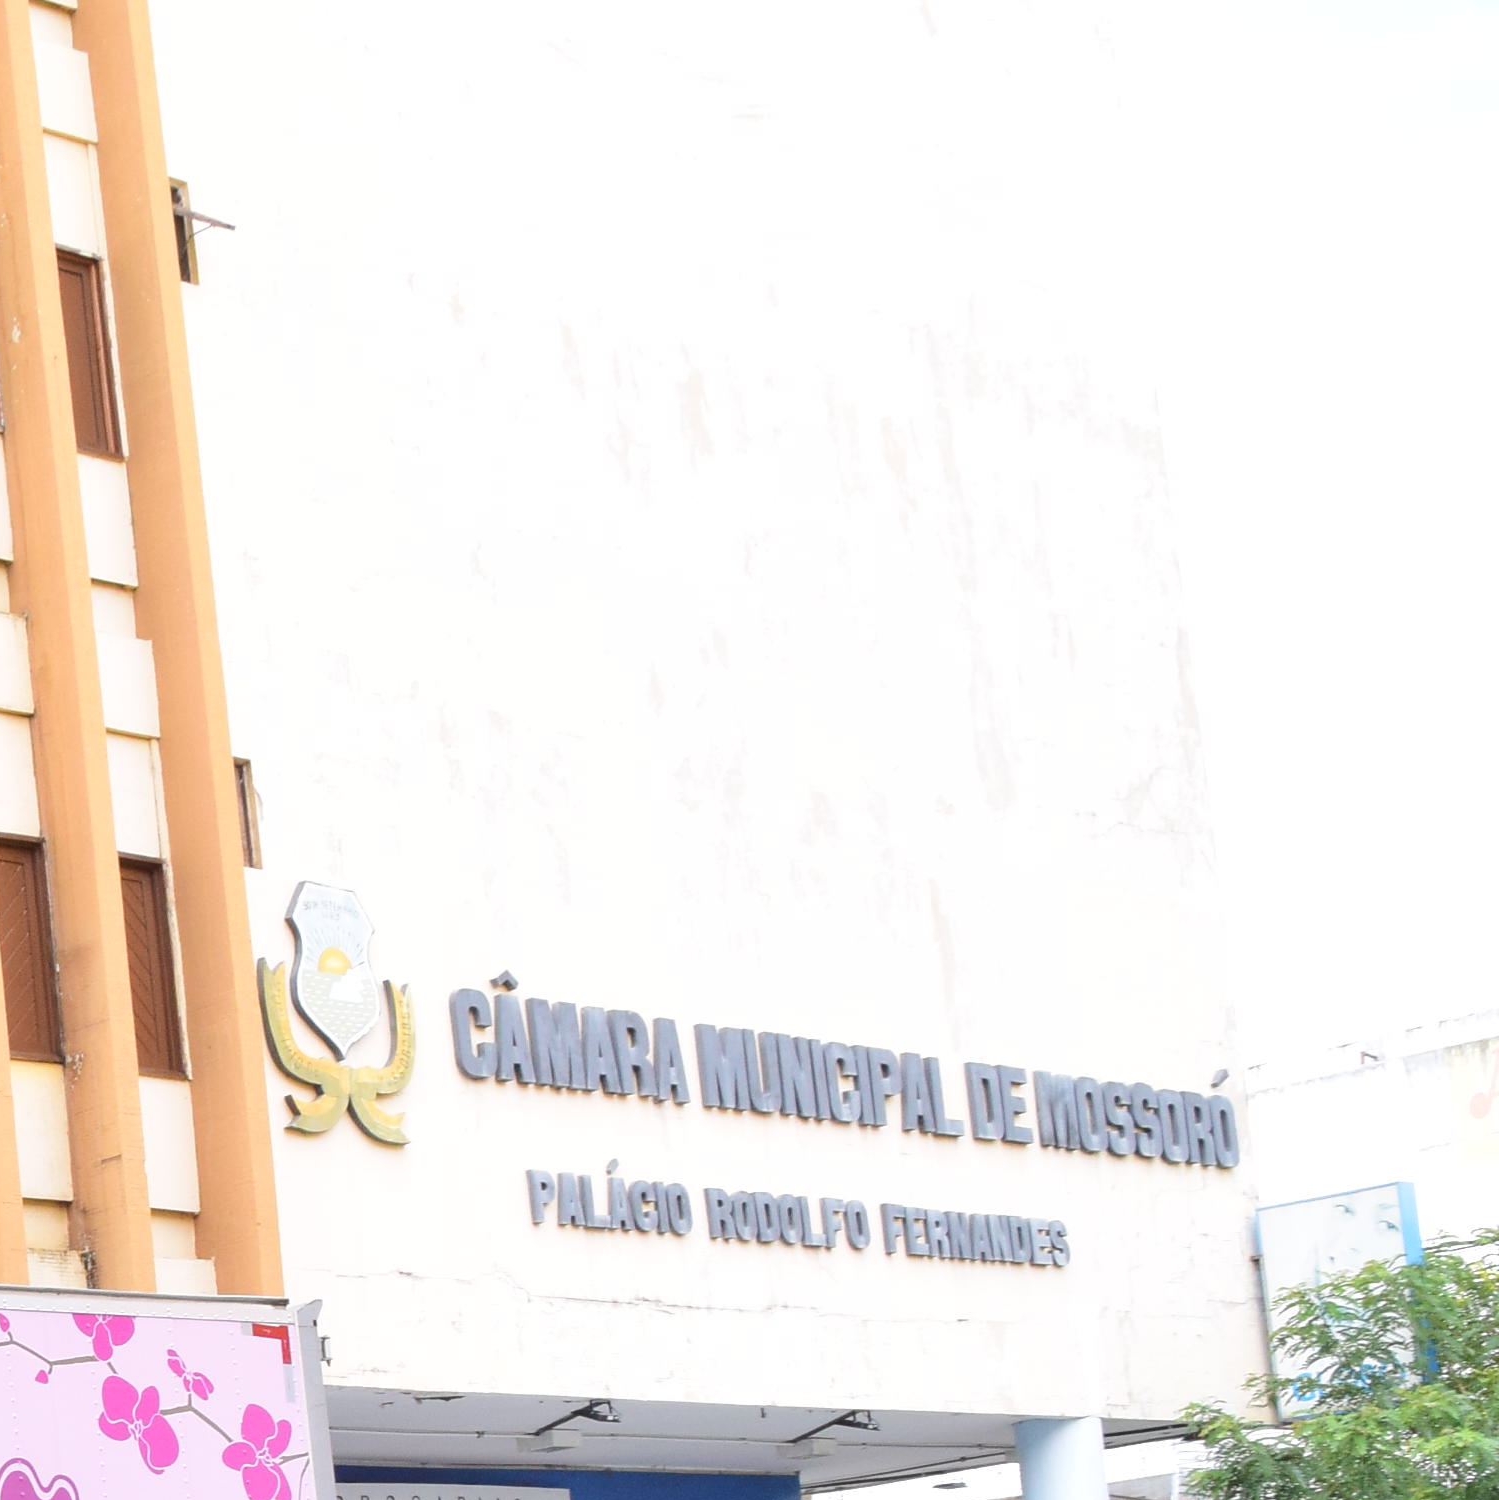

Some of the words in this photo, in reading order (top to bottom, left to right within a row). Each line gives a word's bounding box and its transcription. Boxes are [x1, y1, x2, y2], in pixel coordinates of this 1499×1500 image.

[449, 970, 690, 1104] CÂMARA
[694, 1024, 964, 1137] MUNICIPAL
[964, 1062, 1033, 1144] DE
[1034, 1068, 1240, 1169] MOSSORÓ
[525, 1159, 693, 1236] PALÁCIO
[703, 1187, 870, 1250] RODOLFO
[880, 1203, 1070, 1267] FERNANDES
